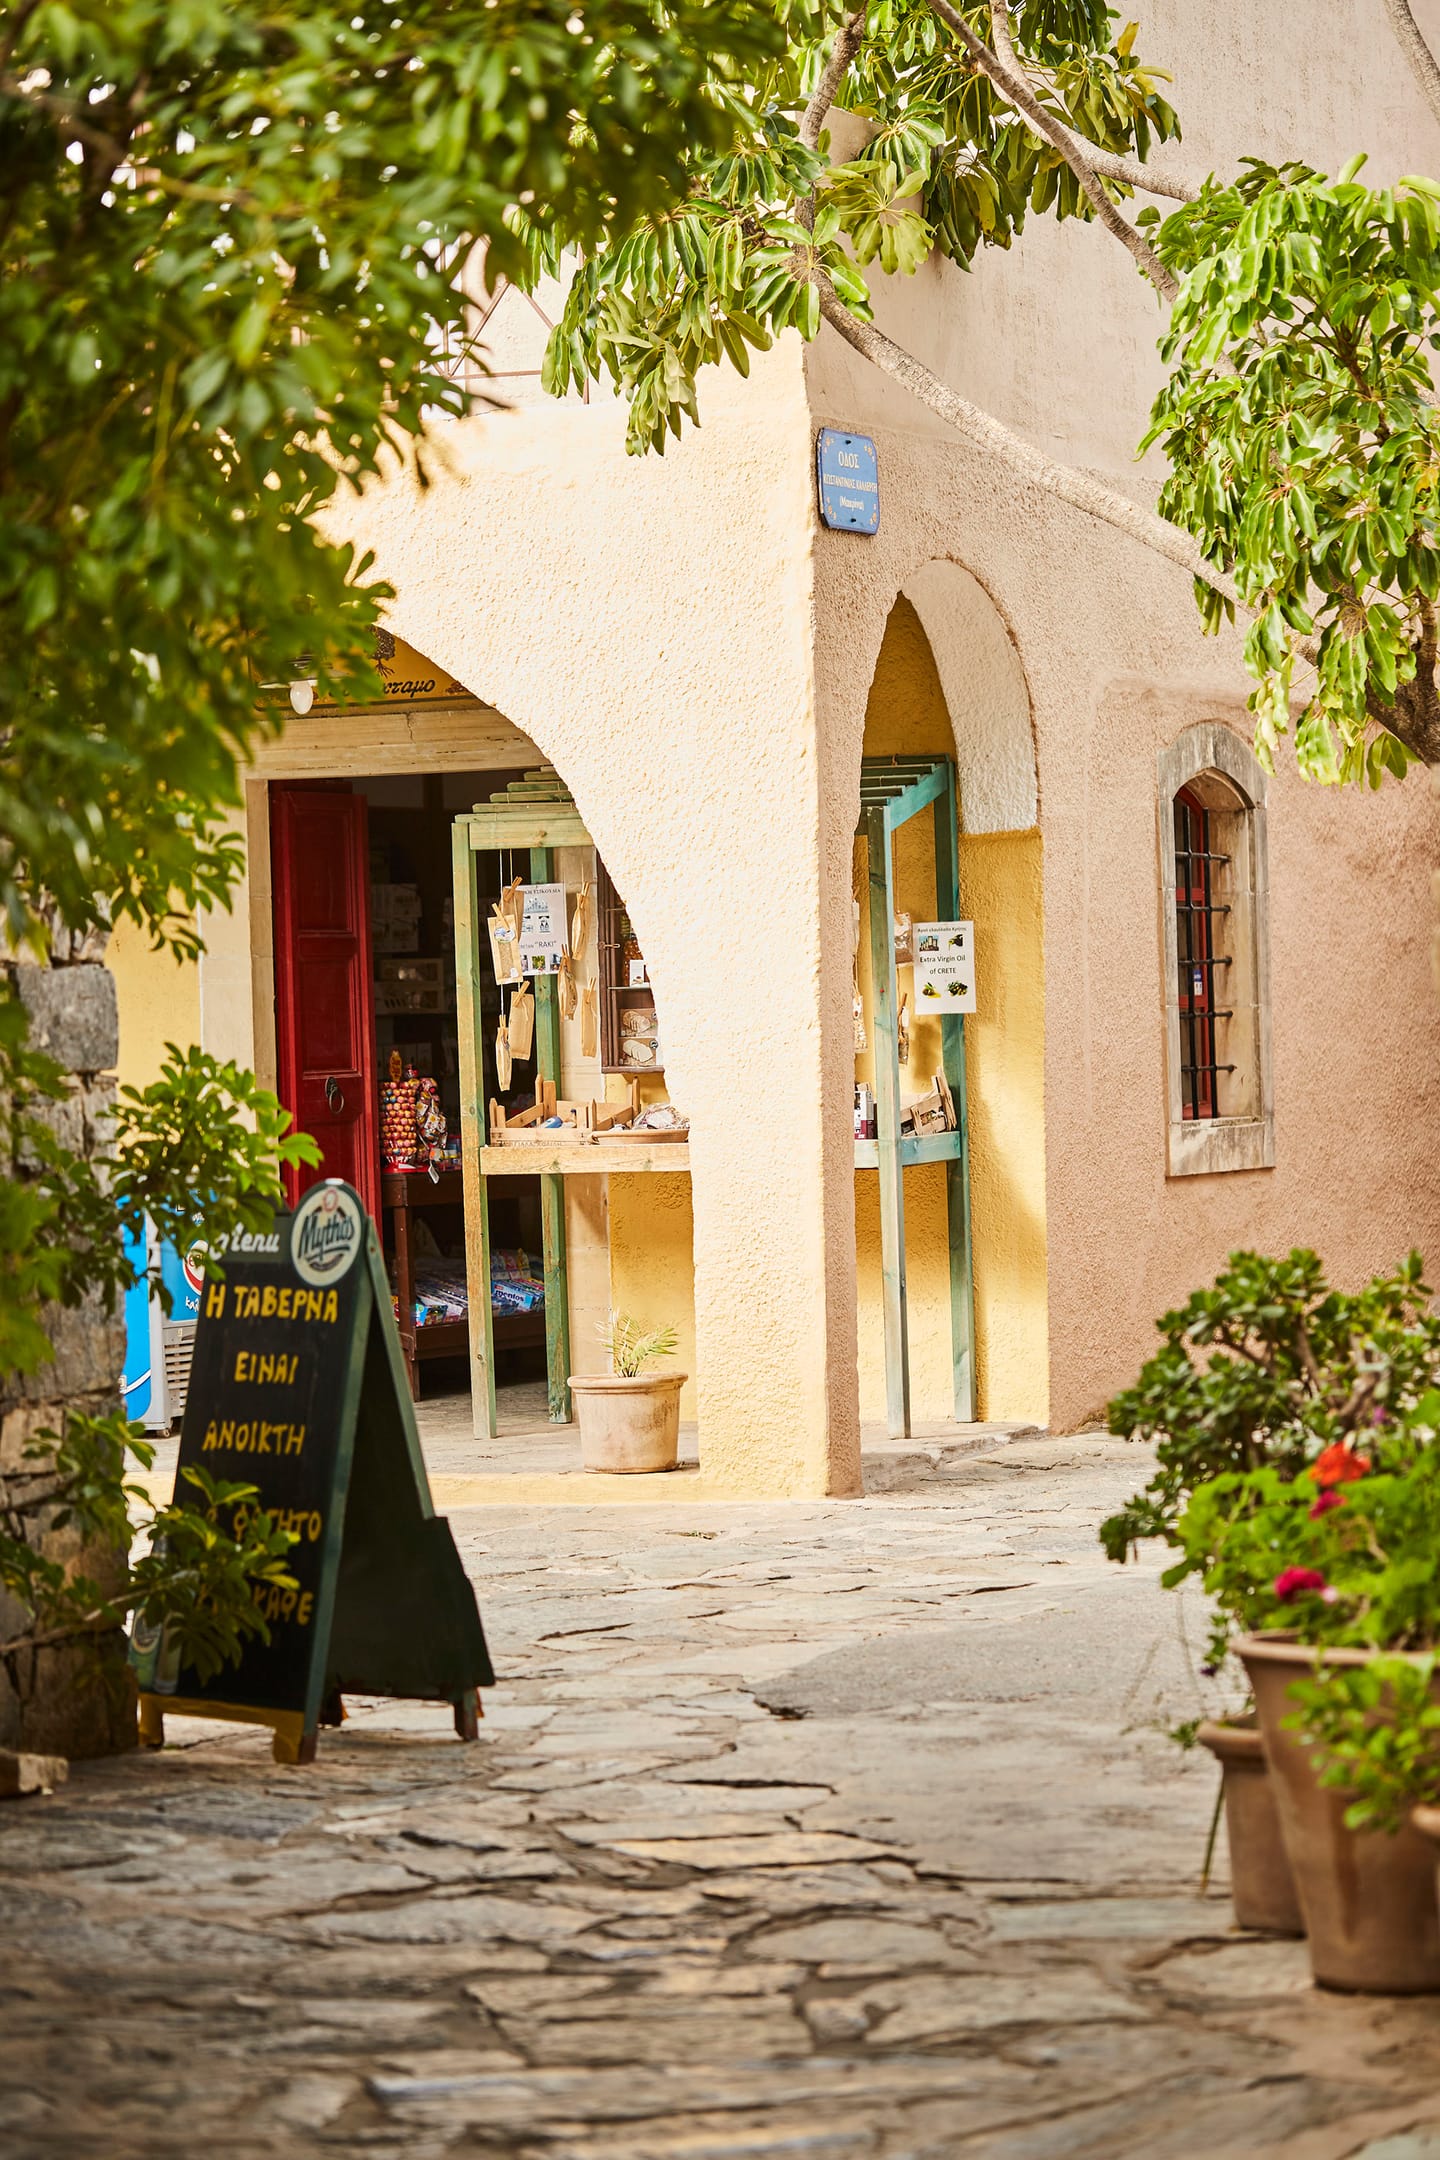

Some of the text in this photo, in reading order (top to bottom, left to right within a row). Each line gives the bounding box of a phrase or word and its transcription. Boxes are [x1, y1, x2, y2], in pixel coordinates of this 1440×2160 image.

[838, 451, 860, 469] ΟΔΟΣ
[298, 1214, 355, 1262] Mythos
[206, 1283, 340, 1323] Η ΤΑΒΕΡΝΑ
[495, 1290, 524, 1302] mentos
[234, 1350, 300, 1385] ΕΙΝΑΙ
[202, 1420, 306, 1457] ΑΝΟΙΚΤΗ
